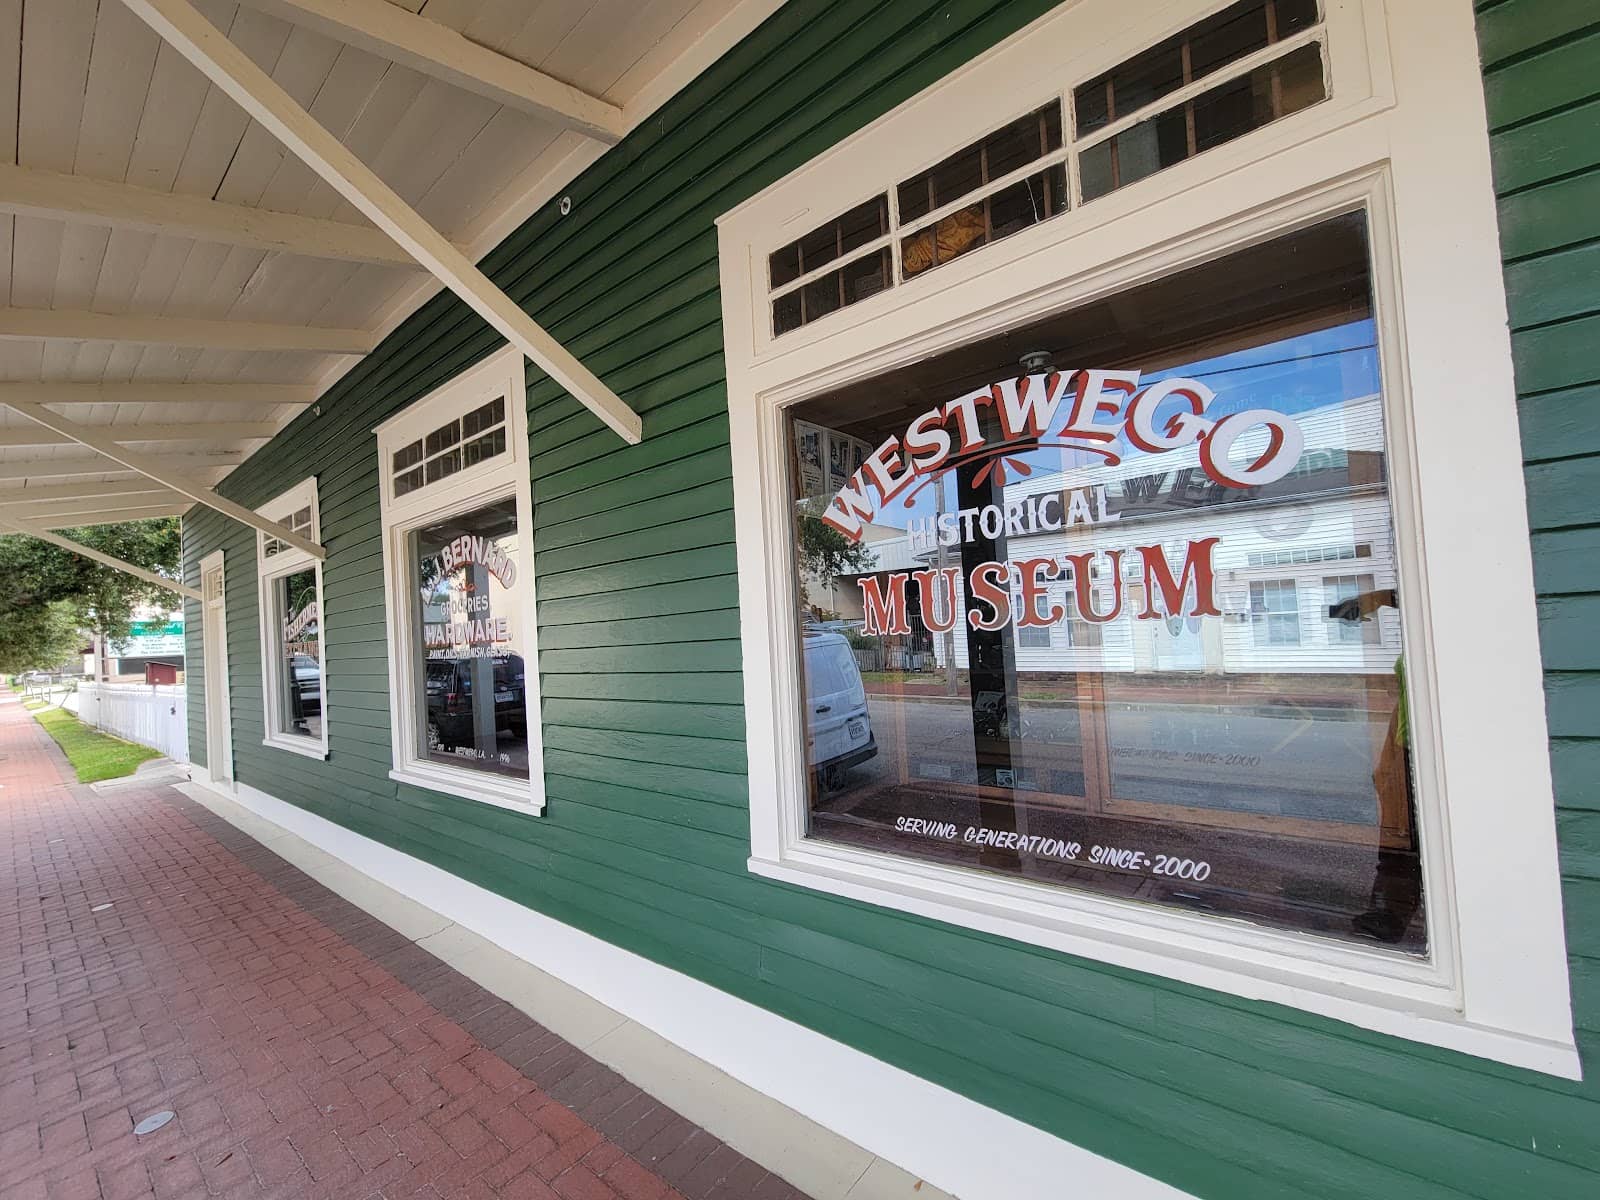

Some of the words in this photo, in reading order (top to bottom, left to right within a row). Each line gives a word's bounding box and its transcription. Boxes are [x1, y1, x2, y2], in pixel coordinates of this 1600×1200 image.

[821, 369, 1303, 541] WESTWEGO
[906, 486, 1121, 552] HISTORICAL
[440, 595, 489, 616] GROCERIES
[857, 536, 1223, 638] MUSEUM
[895, 816, 958, 839] SERVING
[964, 827, 1082, 860] GENERATIONS
